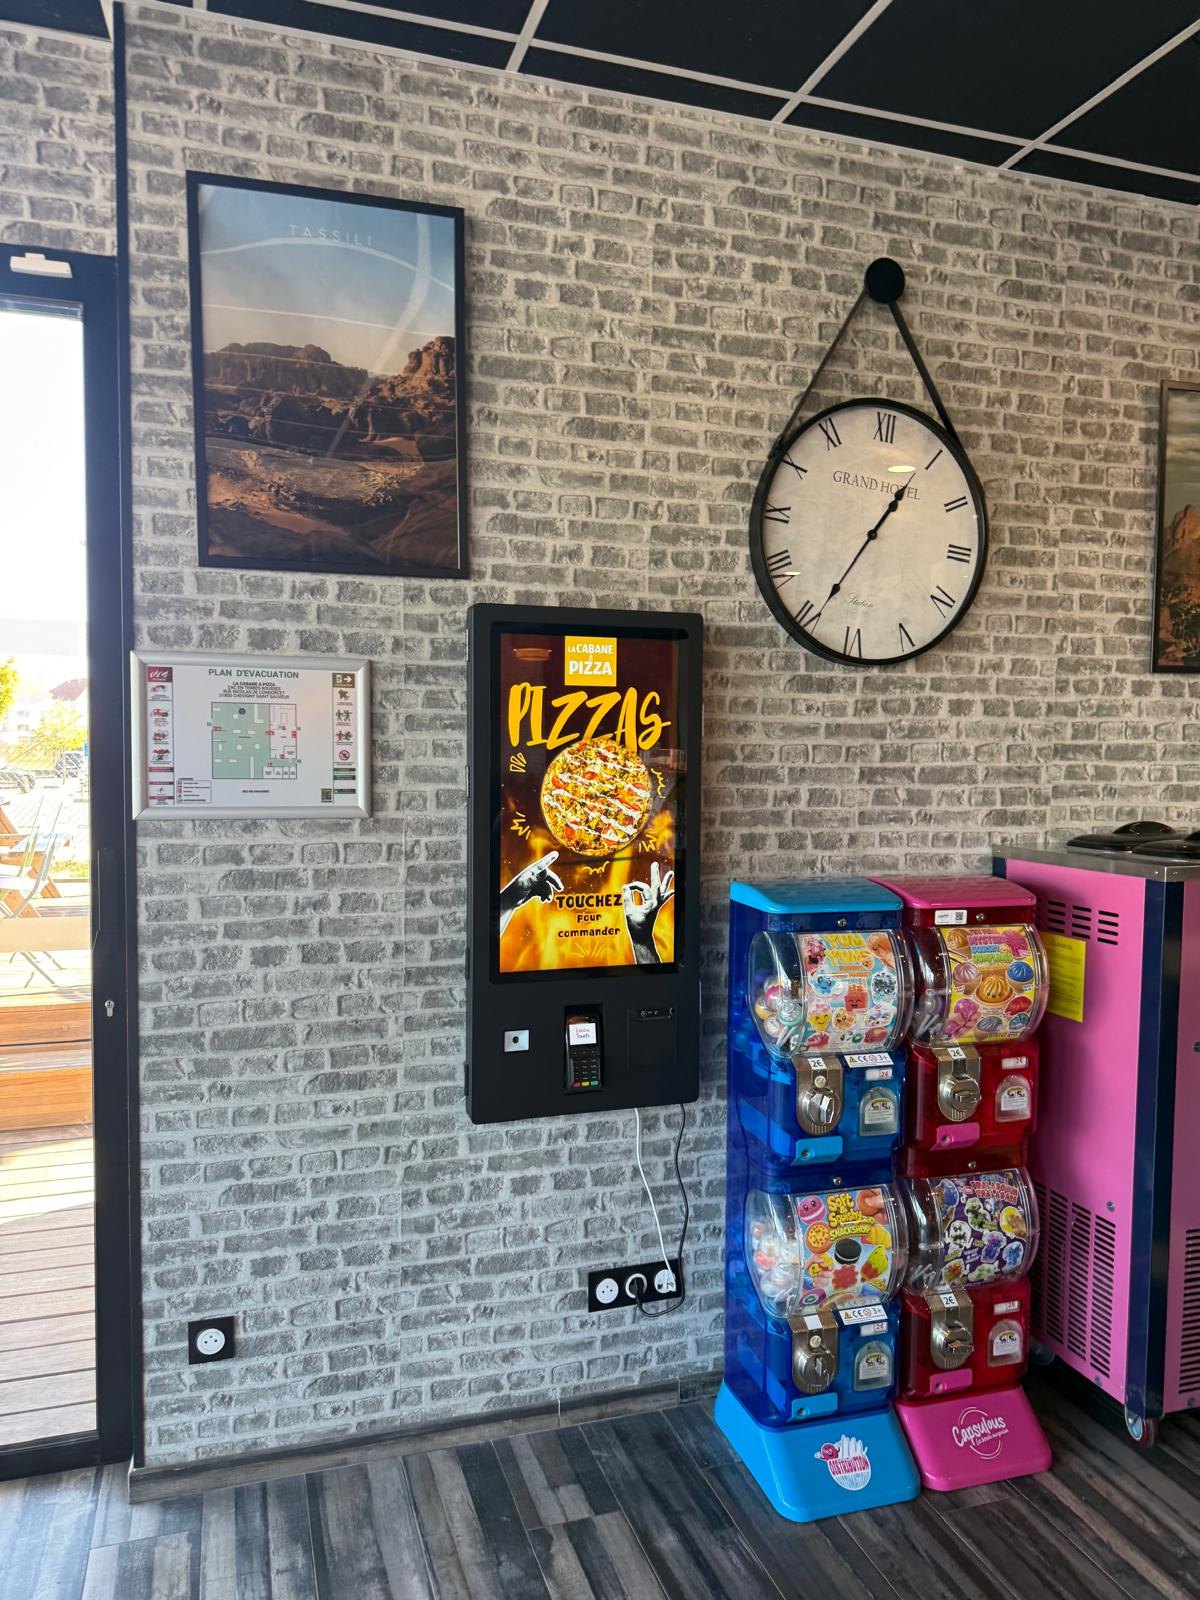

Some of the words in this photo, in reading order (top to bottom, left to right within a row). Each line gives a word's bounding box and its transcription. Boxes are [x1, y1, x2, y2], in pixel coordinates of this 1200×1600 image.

[288, 224, 371, 248] TASSILI
[817, 417, 842, 451] XI
[873, 411, 897, 444] XII
[780, 450, 808, 480] X
[832, 470, 879, 491] GRAND
[943, 495, 968, 513] II
[946, 543, 972, 564] III
[898, 622, 916, 653] V
[576, 643, 613, 655] CABANE
[208, 668, 232, 677] PLAN
[236, 669, 299, 679] D'EVACUATION
[568, 660, 613, 676] PIZZA
[508, 681, 672, 752] PIZZAS
[556, 894, 623, 909] TOUCHEZ
[577, 914, 602, 923] pour
[558, 926, 621, 938] commander
[951, 1049, 963, 1057] 2€
[811, 1059, 823, 1068] 2€
[826, 1193, 855, 1211] Soft
[828, 1210, 862, 1228] Squishy
[830, 1225, 871, 1241] SNACKSHOP
[943, 1296, 955, 1305] 2€
[952, 1417, 1006, 1448] Capsulous
